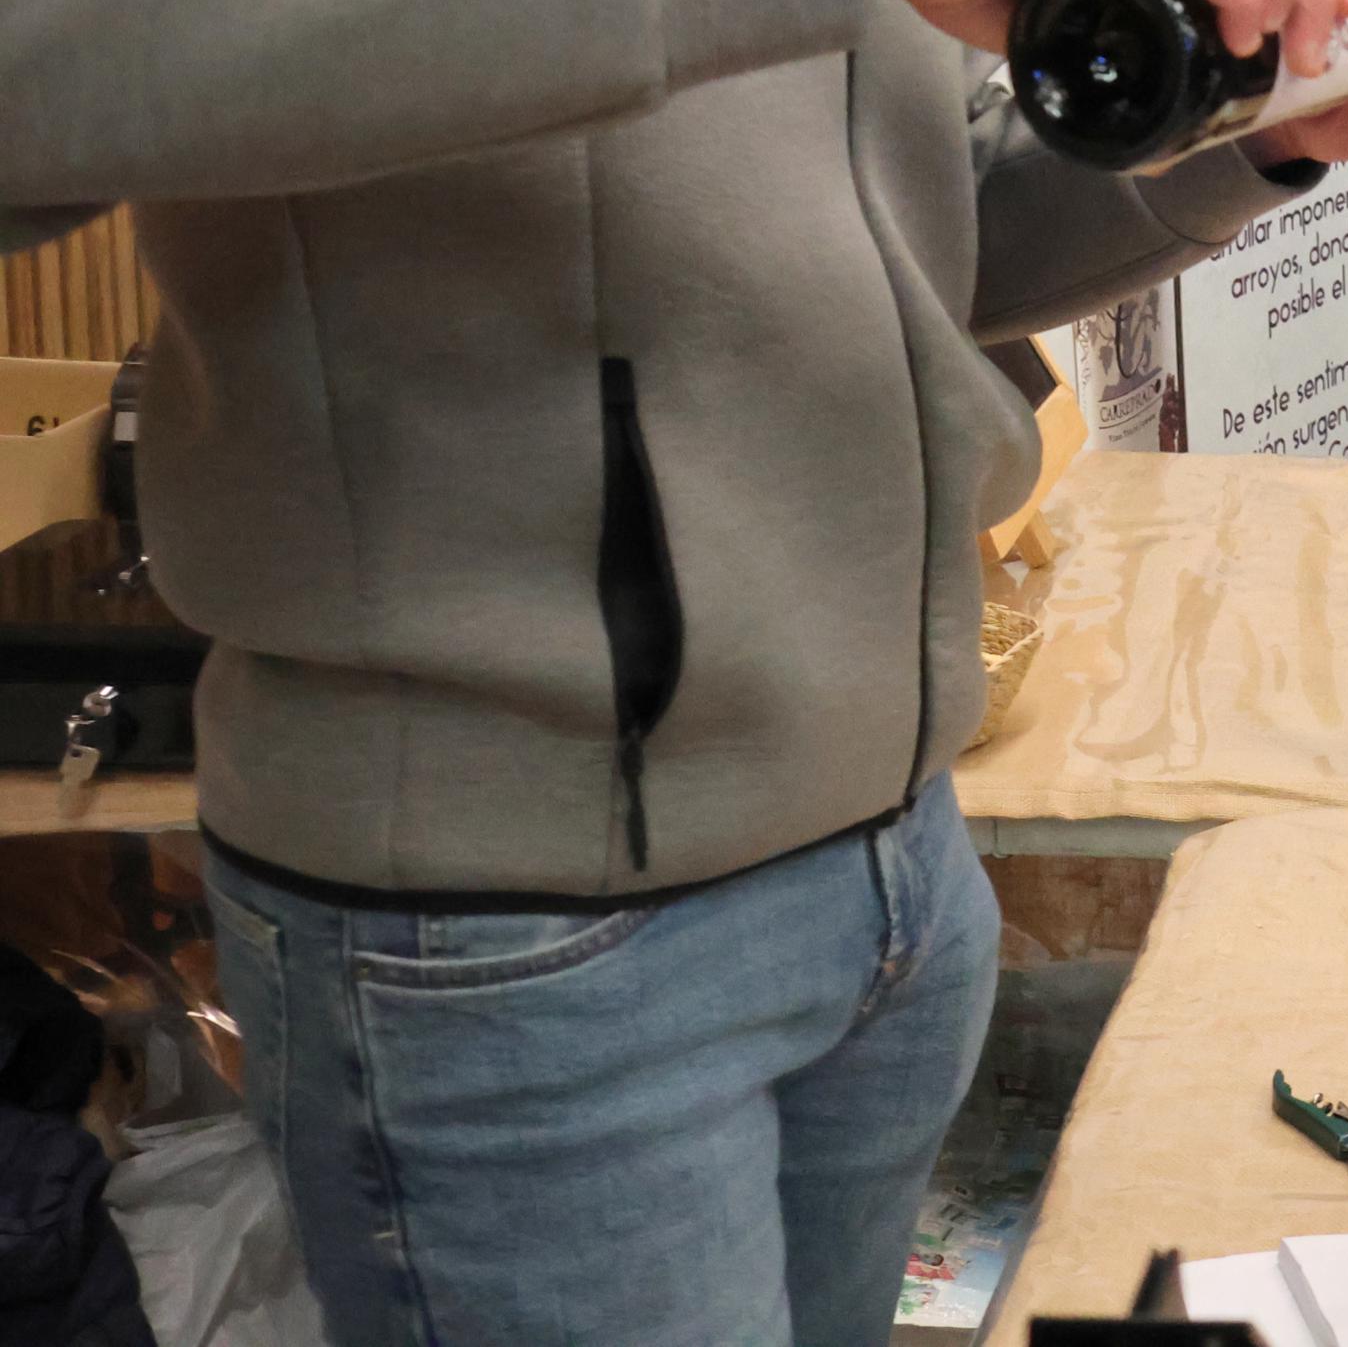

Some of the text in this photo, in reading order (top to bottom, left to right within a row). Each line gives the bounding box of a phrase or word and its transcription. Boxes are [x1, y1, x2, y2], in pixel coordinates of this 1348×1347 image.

[1231, 254, 1303, 299] arroyos,
[1268, 277, 1325, 339] posible
[1332, 264, 1347, 301] el
[1222, 407, 1245, 439] De
[1252, 384, 1290, 424] este
[1292, 405, 1348, 450] surgen
